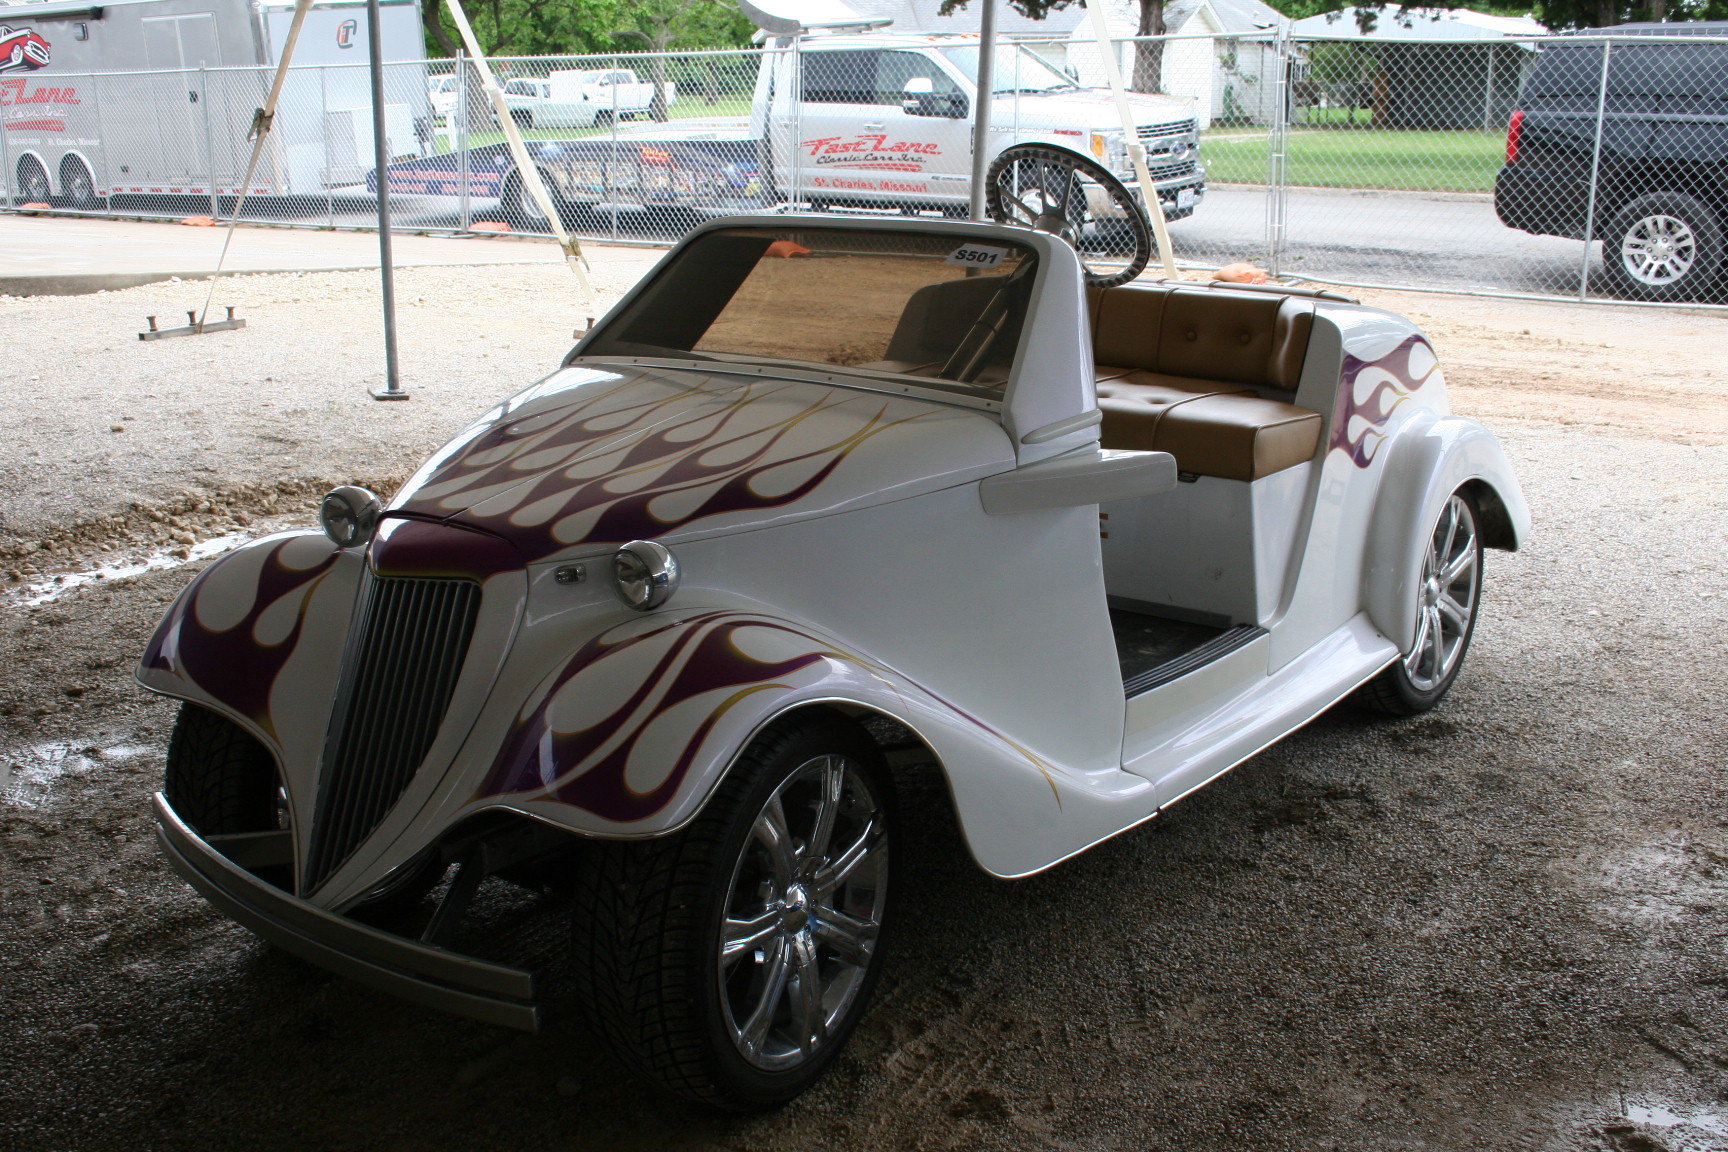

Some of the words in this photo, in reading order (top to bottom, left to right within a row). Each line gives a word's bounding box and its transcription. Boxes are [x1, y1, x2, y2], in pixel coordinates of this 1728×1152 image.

[1, 79, 81, 104] Lane
[801, 136, 868, 156] Fast
[855, 134, 943, 155] Lane
[864, 153, 898, 162] Cars
[814, 177, 829, 187] St.
[880, 180, 929, 192] Missouri
[955, 249, 998, 264] S501
